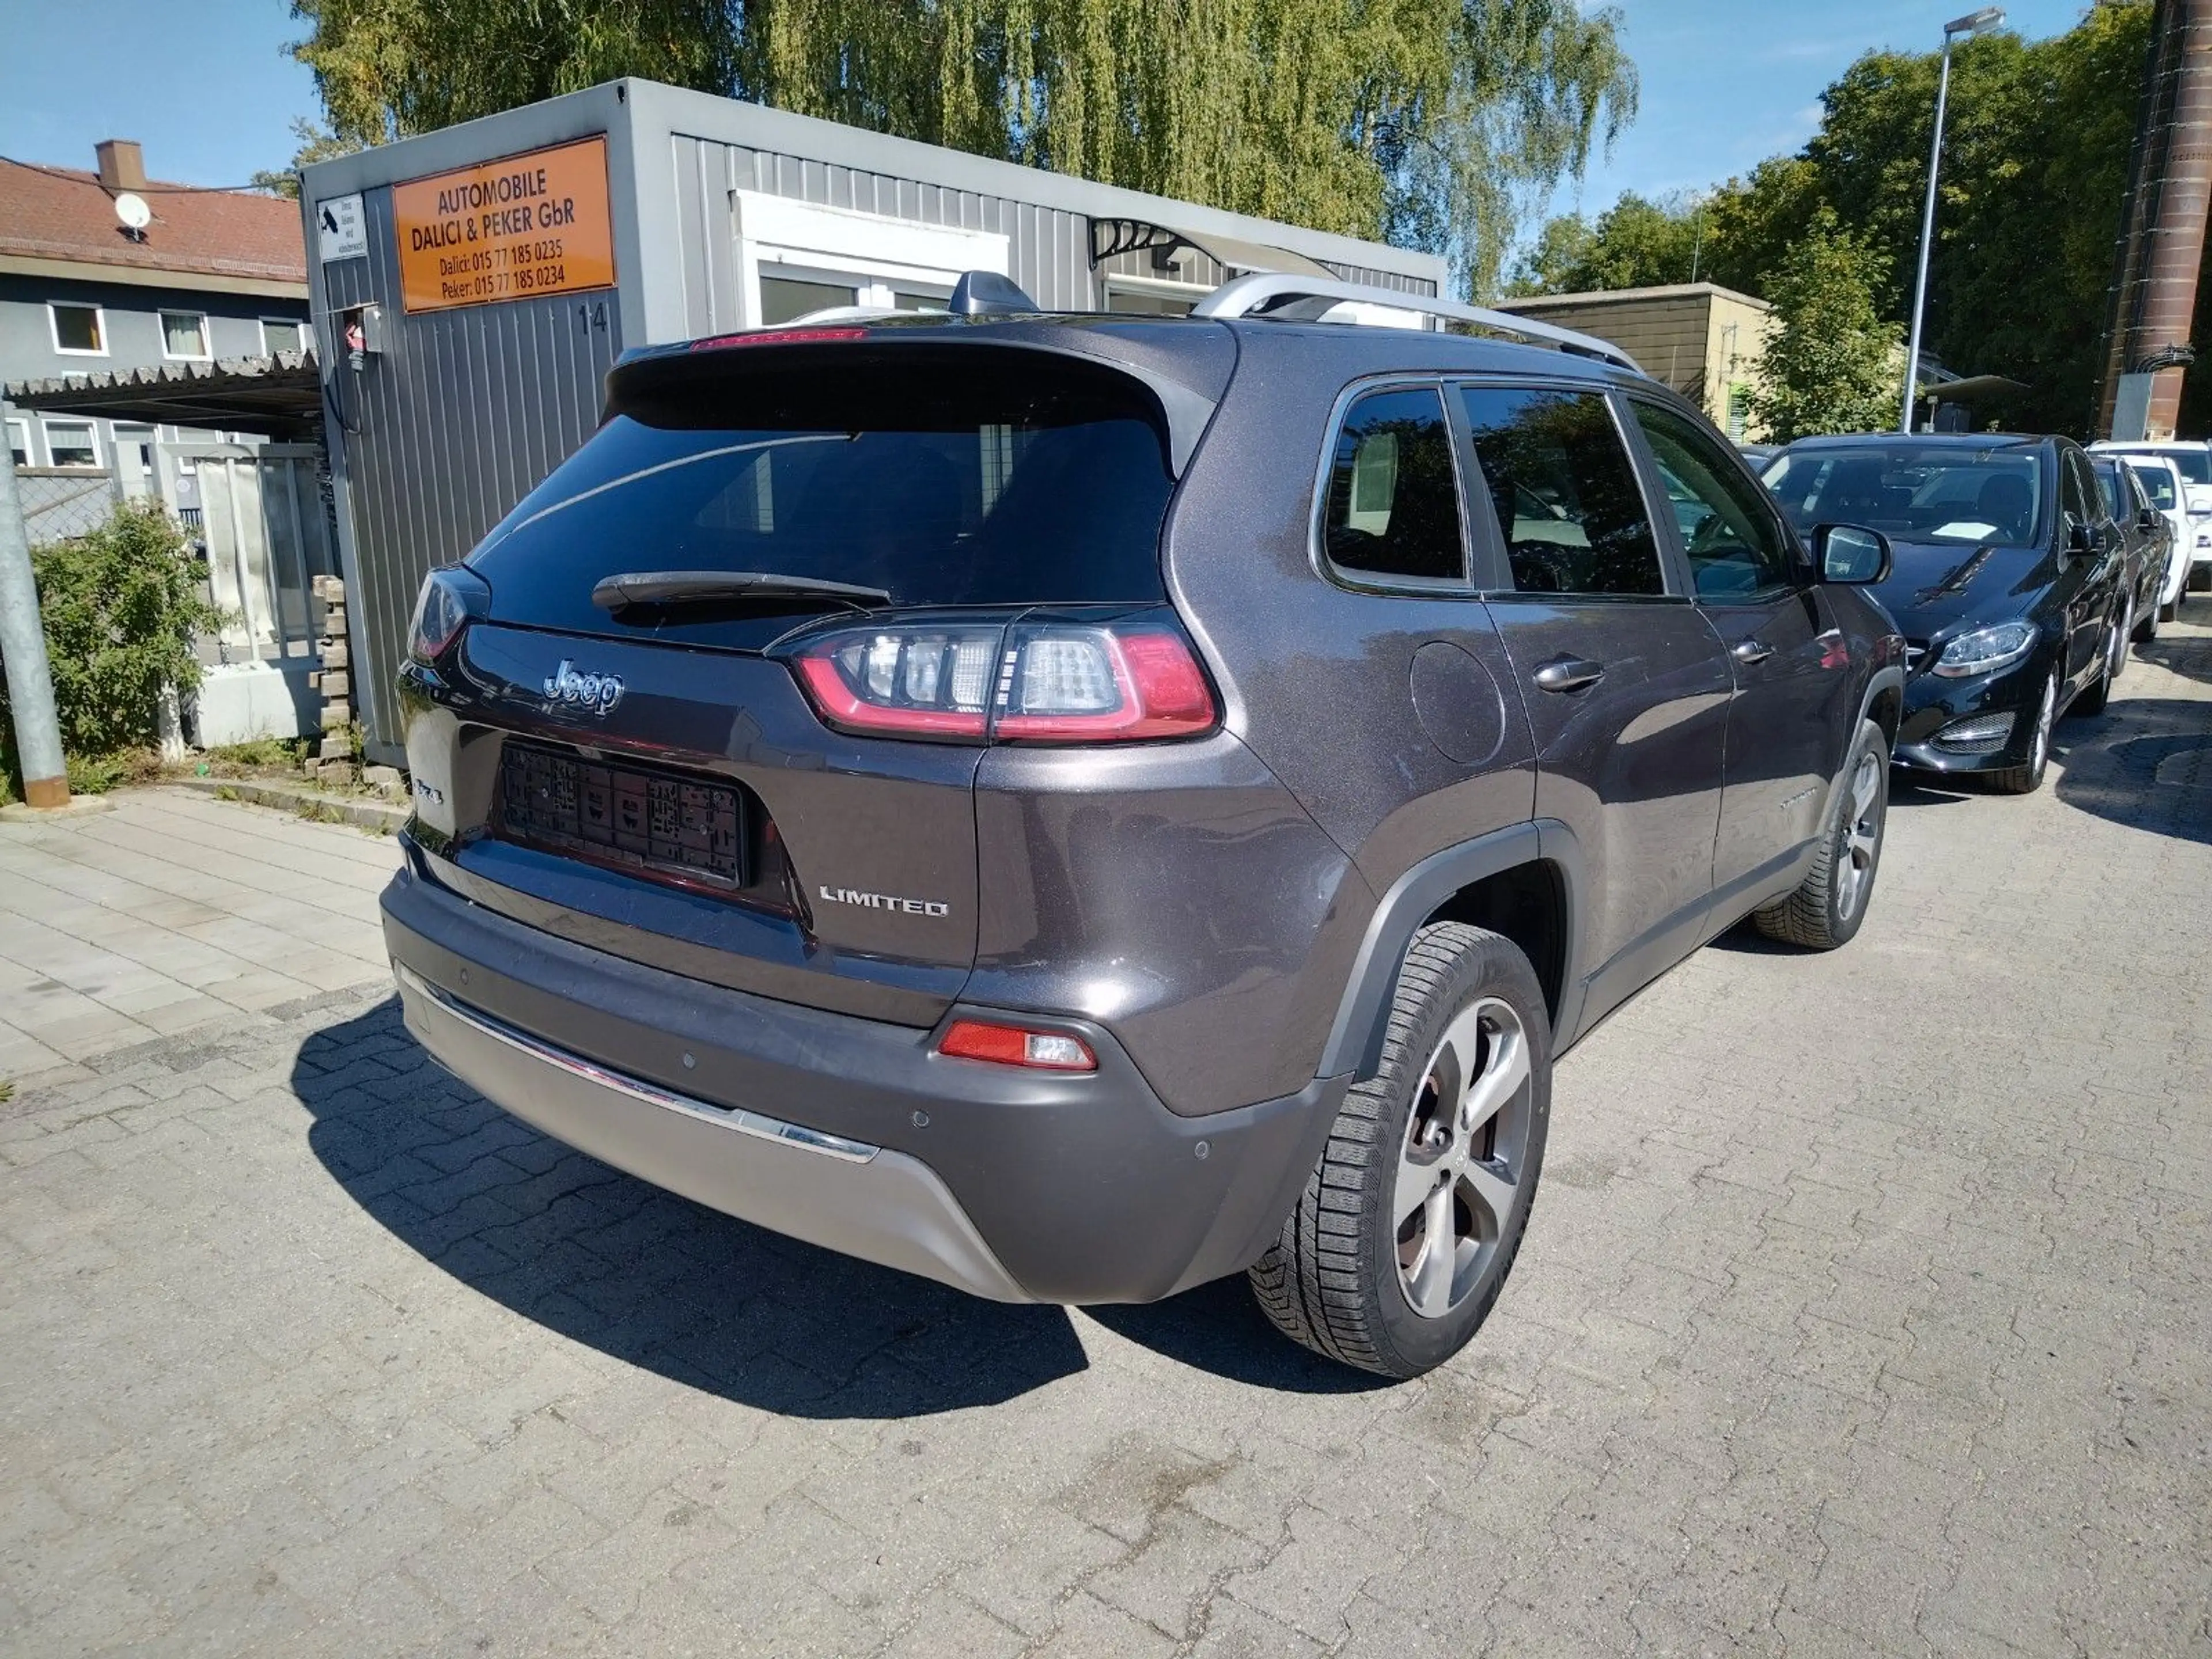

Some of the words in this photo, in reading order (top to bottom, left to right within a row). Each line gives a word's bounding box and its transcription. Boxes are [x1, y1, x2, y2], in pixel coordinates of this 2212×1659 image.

[439, 169, 547, 215] AUTOMOBILE
[412, 220, 461, 252] DALICI
[467, 217, 478, 242] &
[483, 206, 533, 238] PEKER
[539, 198, 575, 229] GbR
[440, 254, 471, 276] Dalici:
[472, 251, 492, 271] 015
[495, 248, 507, 267] 77
[512, 244, 532, 265] 185
[535, 239, 562, 261] 0235
[442, 280, 472, 300] Peker:
[475, 275, 494, 296] 015
[497, 273, 510, 291] 77
[514, 270, 533, 289] 185
[536, 264, 565, 286] 0234
[579, 302, 607, 335] 14
[543, 658, 624, 716] Jeep
[819, 885, 948, 918] LIMITED
